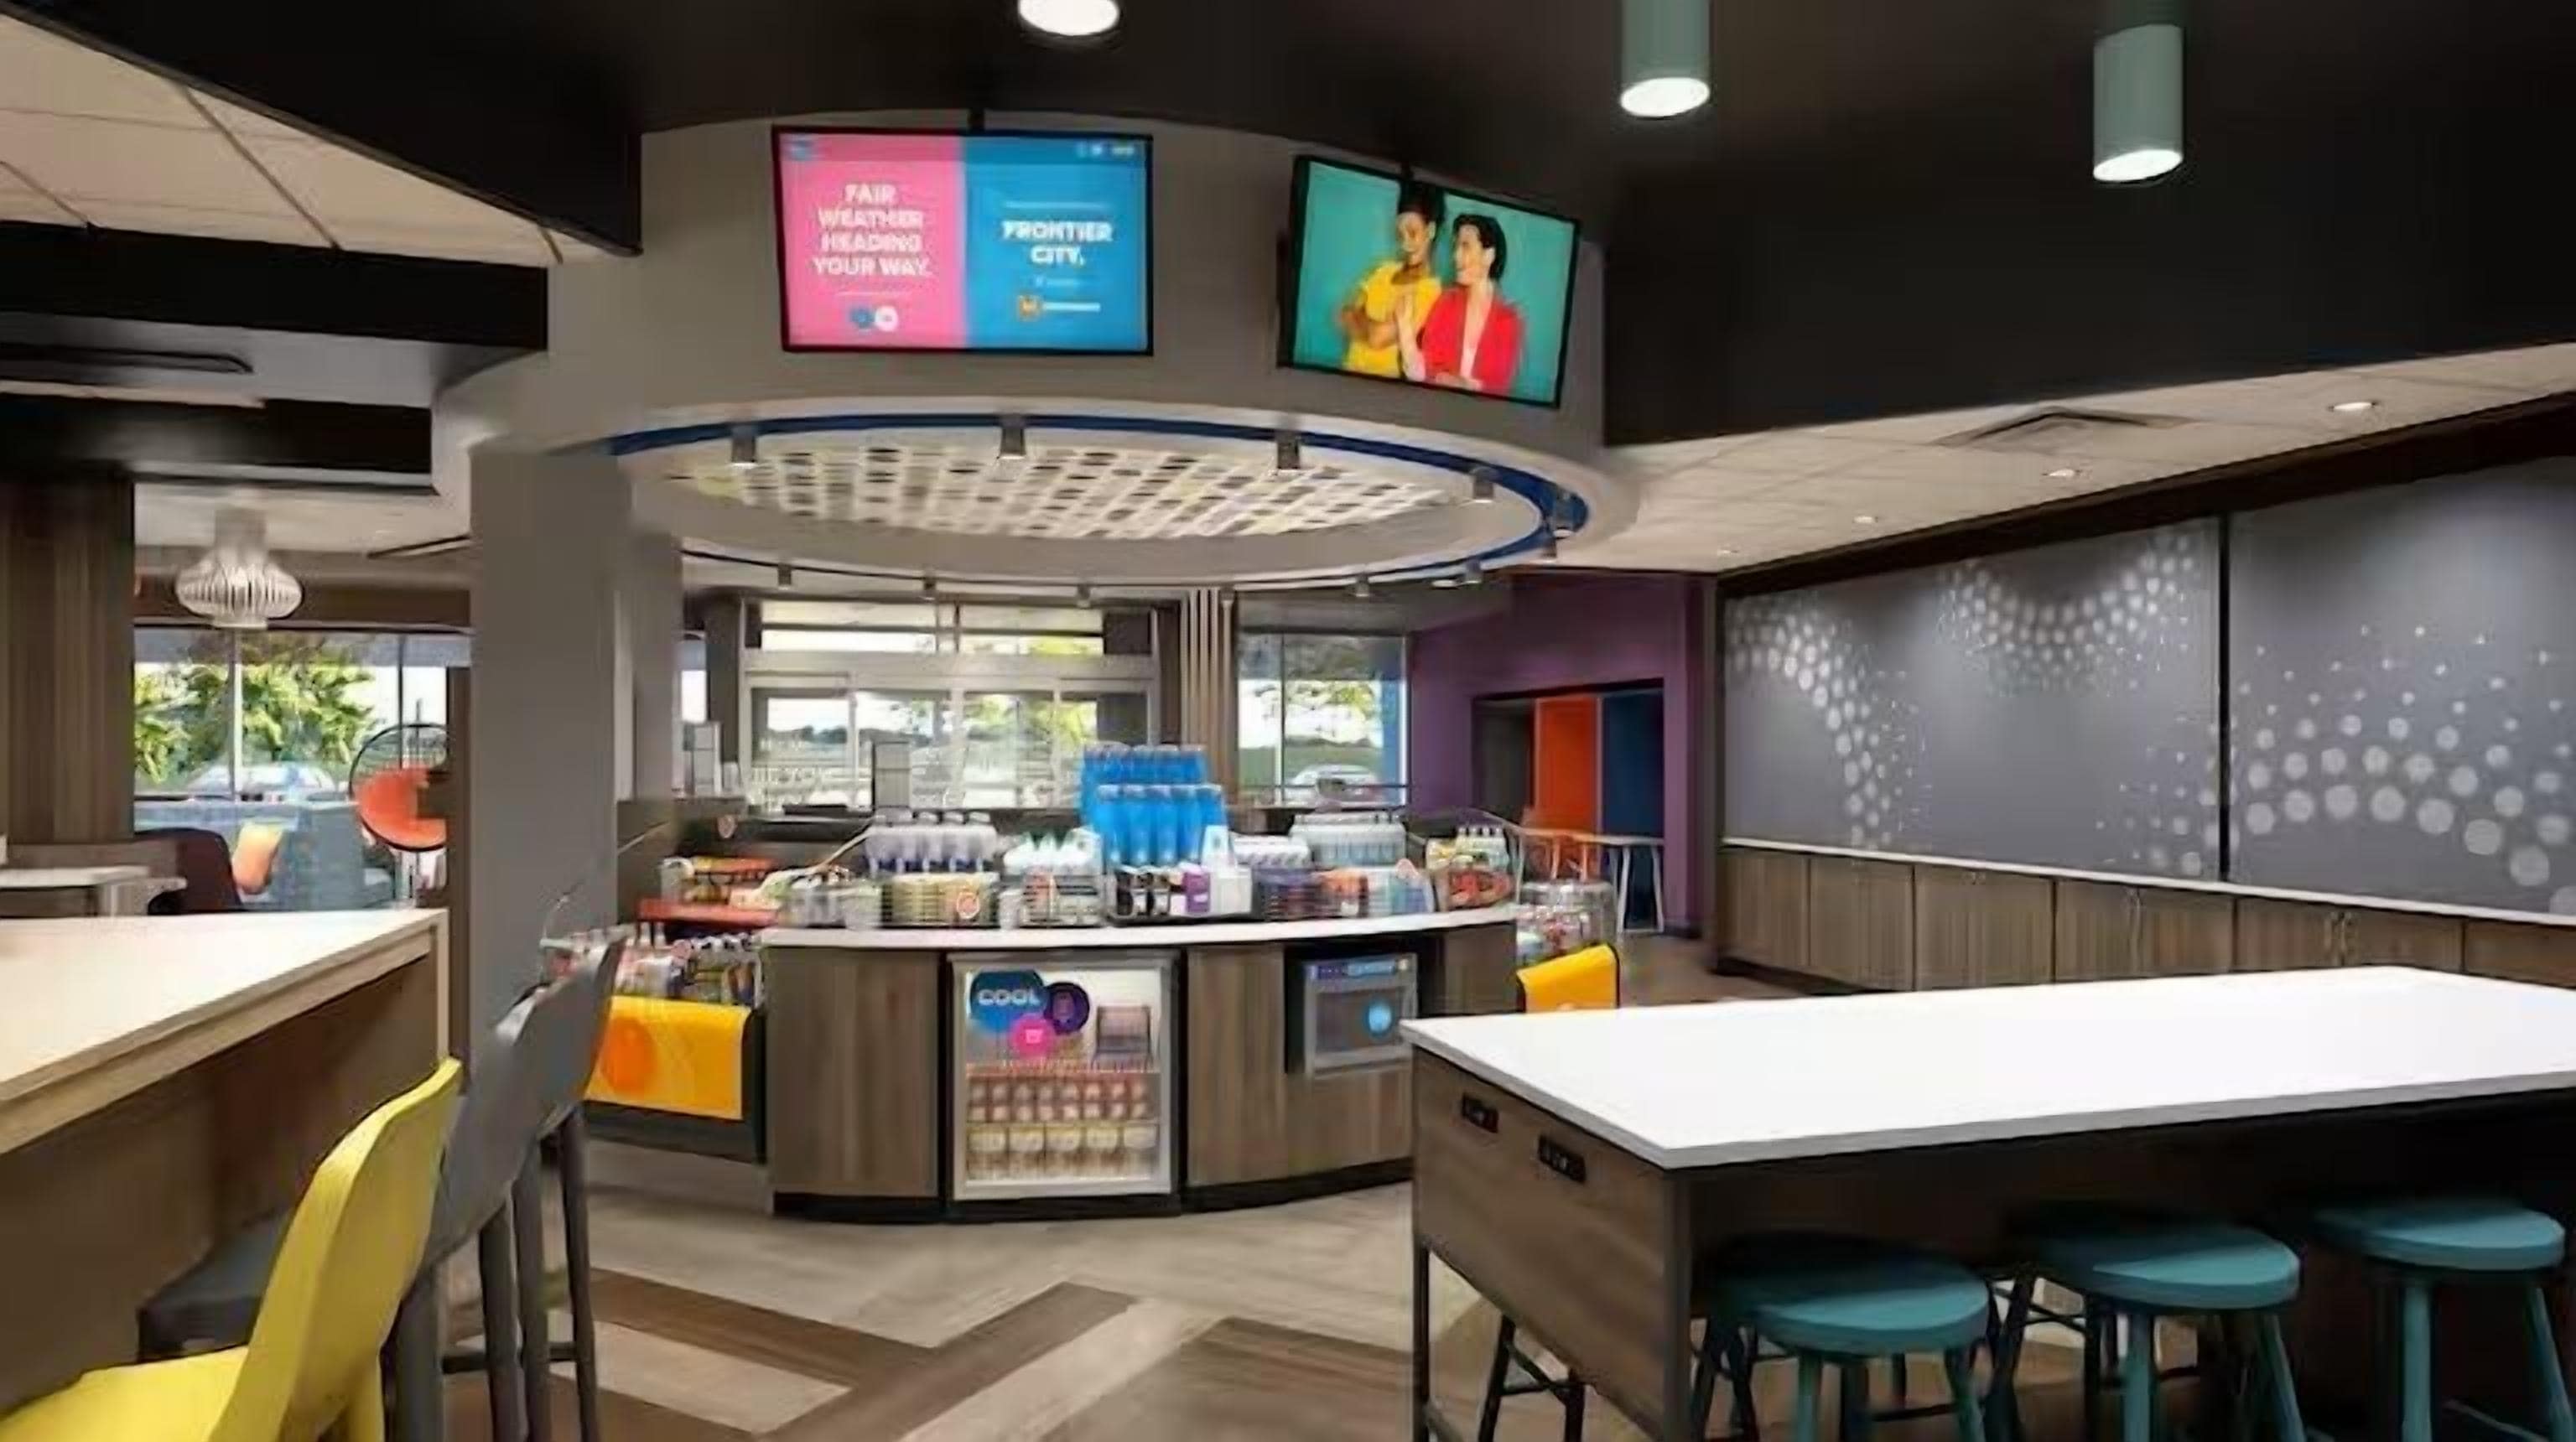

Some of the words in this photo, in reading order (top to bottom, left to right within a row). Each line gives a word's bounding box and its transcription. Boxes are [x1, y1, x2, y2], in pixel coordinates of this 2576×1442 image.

[844, 183, 896, 203] FAIR
[818, 208, 924, 228] WEATHER
[1001, 220, 1113, 242] FRONTIER
[821, 233, 922, 252] HEADING
[813, 257, 875, 276] YOUR
[978, 989, 1041, 1006] COOL
